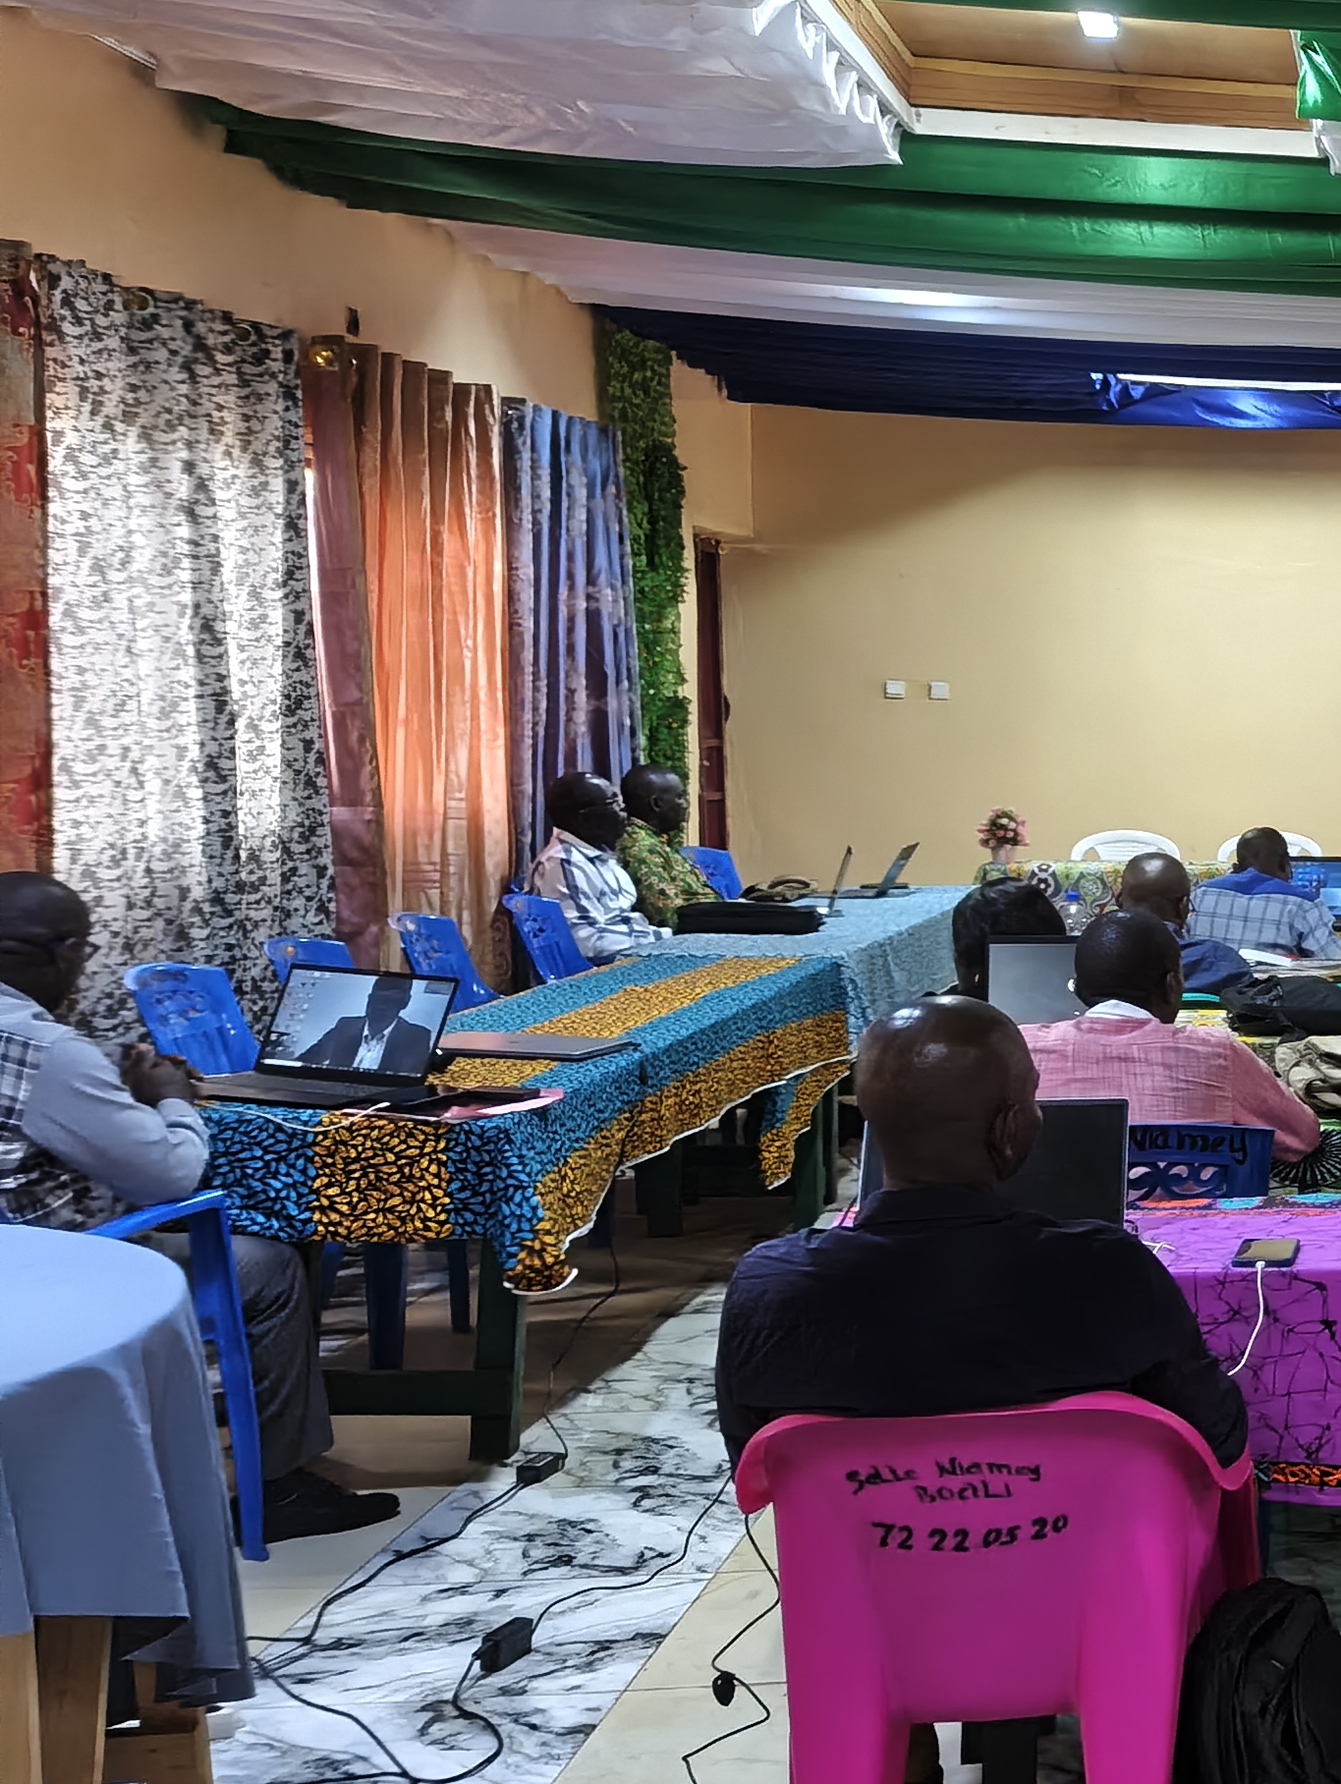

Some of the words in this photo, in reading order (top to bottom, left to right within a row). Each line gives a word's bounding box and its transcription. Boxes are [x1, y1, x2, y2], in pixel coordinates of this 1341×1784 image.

[871, 1520, 914, 1551] 72
[928, 1527, 971, 1553] 22
[982, 1524, 1022, 1549] 05
[1030, 1513, 1069, 1540] 20
